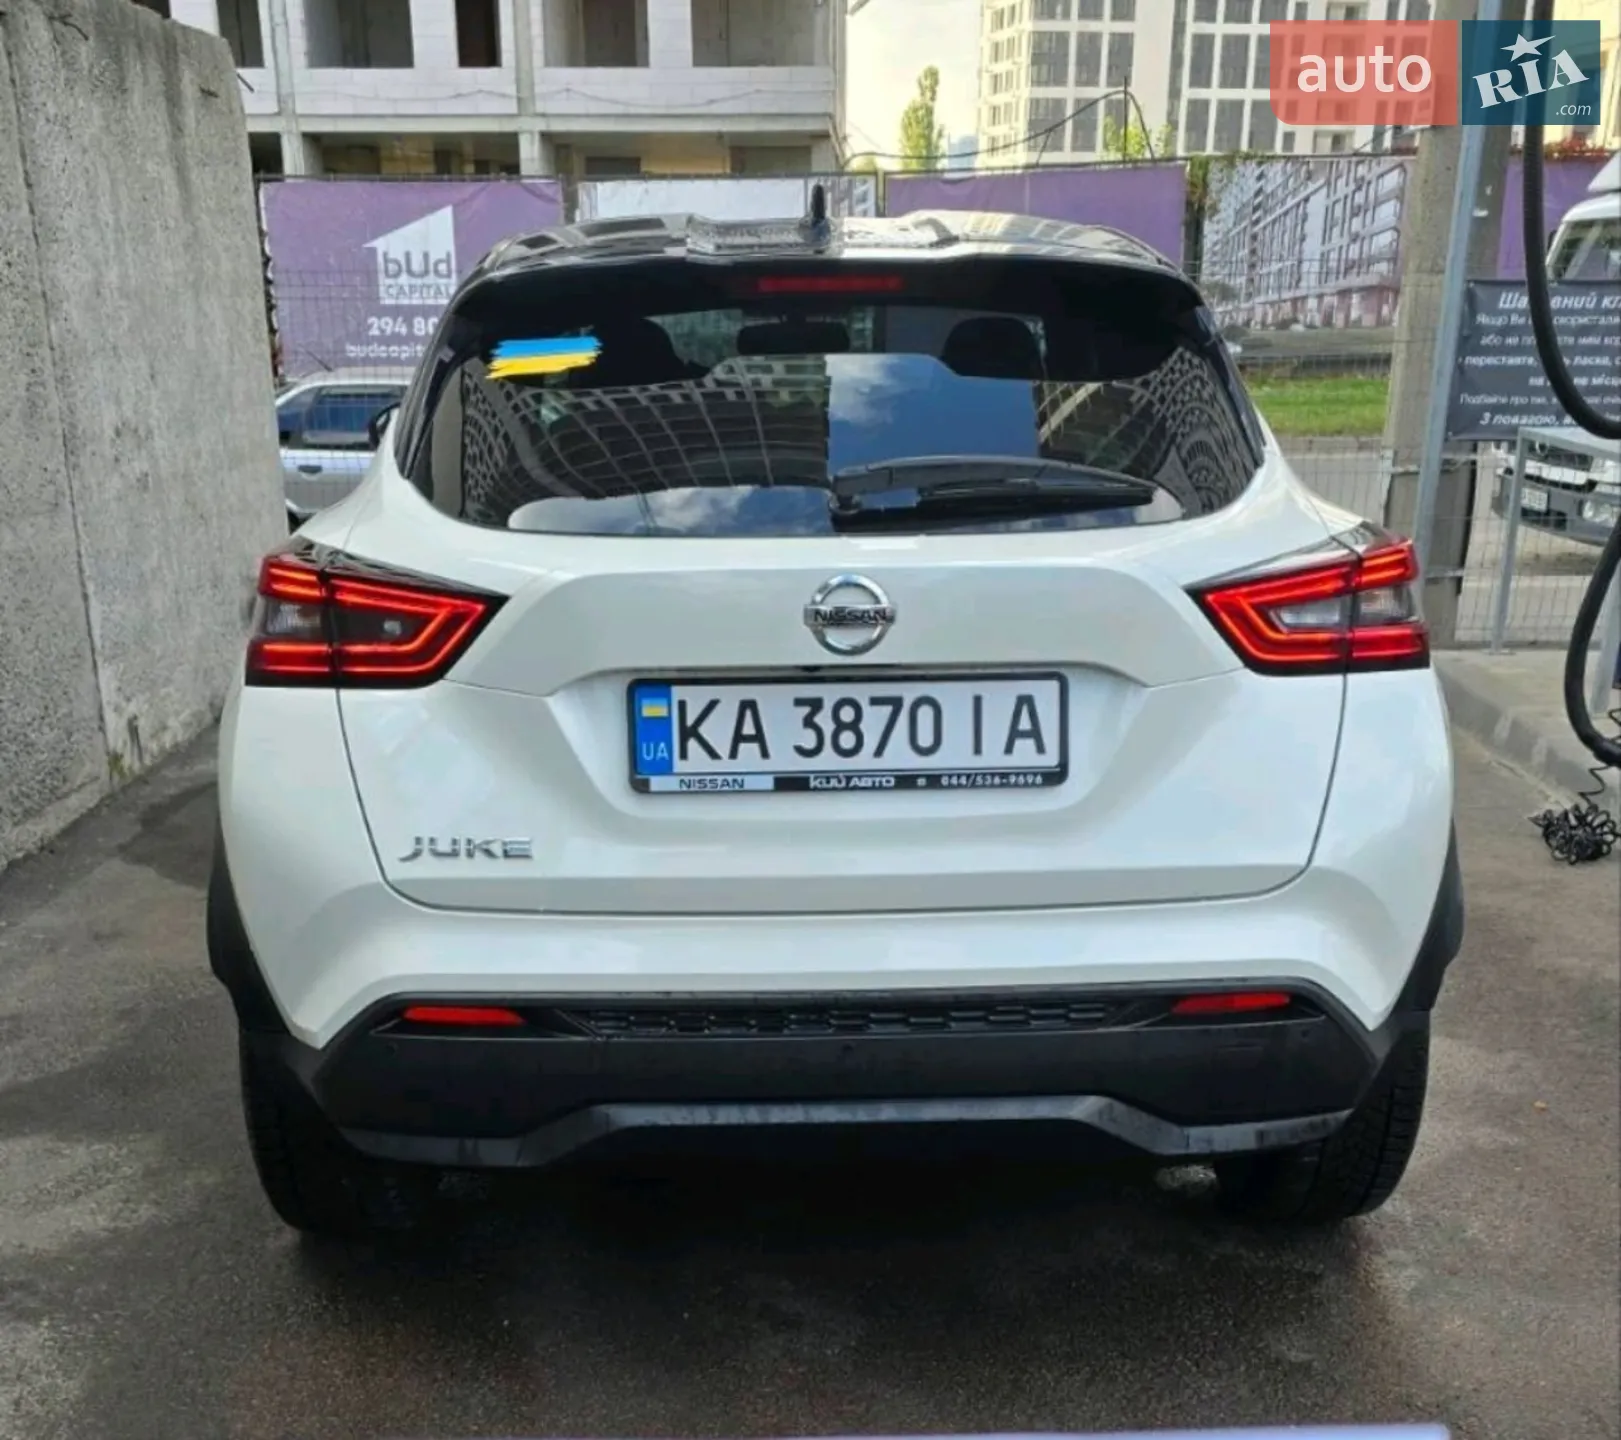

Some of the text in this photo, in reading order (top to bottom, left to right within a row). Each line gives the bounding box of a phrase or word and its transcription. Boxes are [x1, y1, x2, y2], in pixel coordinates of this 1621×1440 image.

[385, 283, 452, 297] CAPITAL
[1498, 291, 1597, 309] Шавний
[367, 317, 408, 336] 294
[345, 343, 427, 360] budcapit
[814, 608, 886, 623] NISSAN
[678, 694, 1046, 760] KA 3870 IA
[641, 742, 670, 761] UA
[679, 778, 745, 790] NISSAN
[398, 836, 533, 862] JUKE
